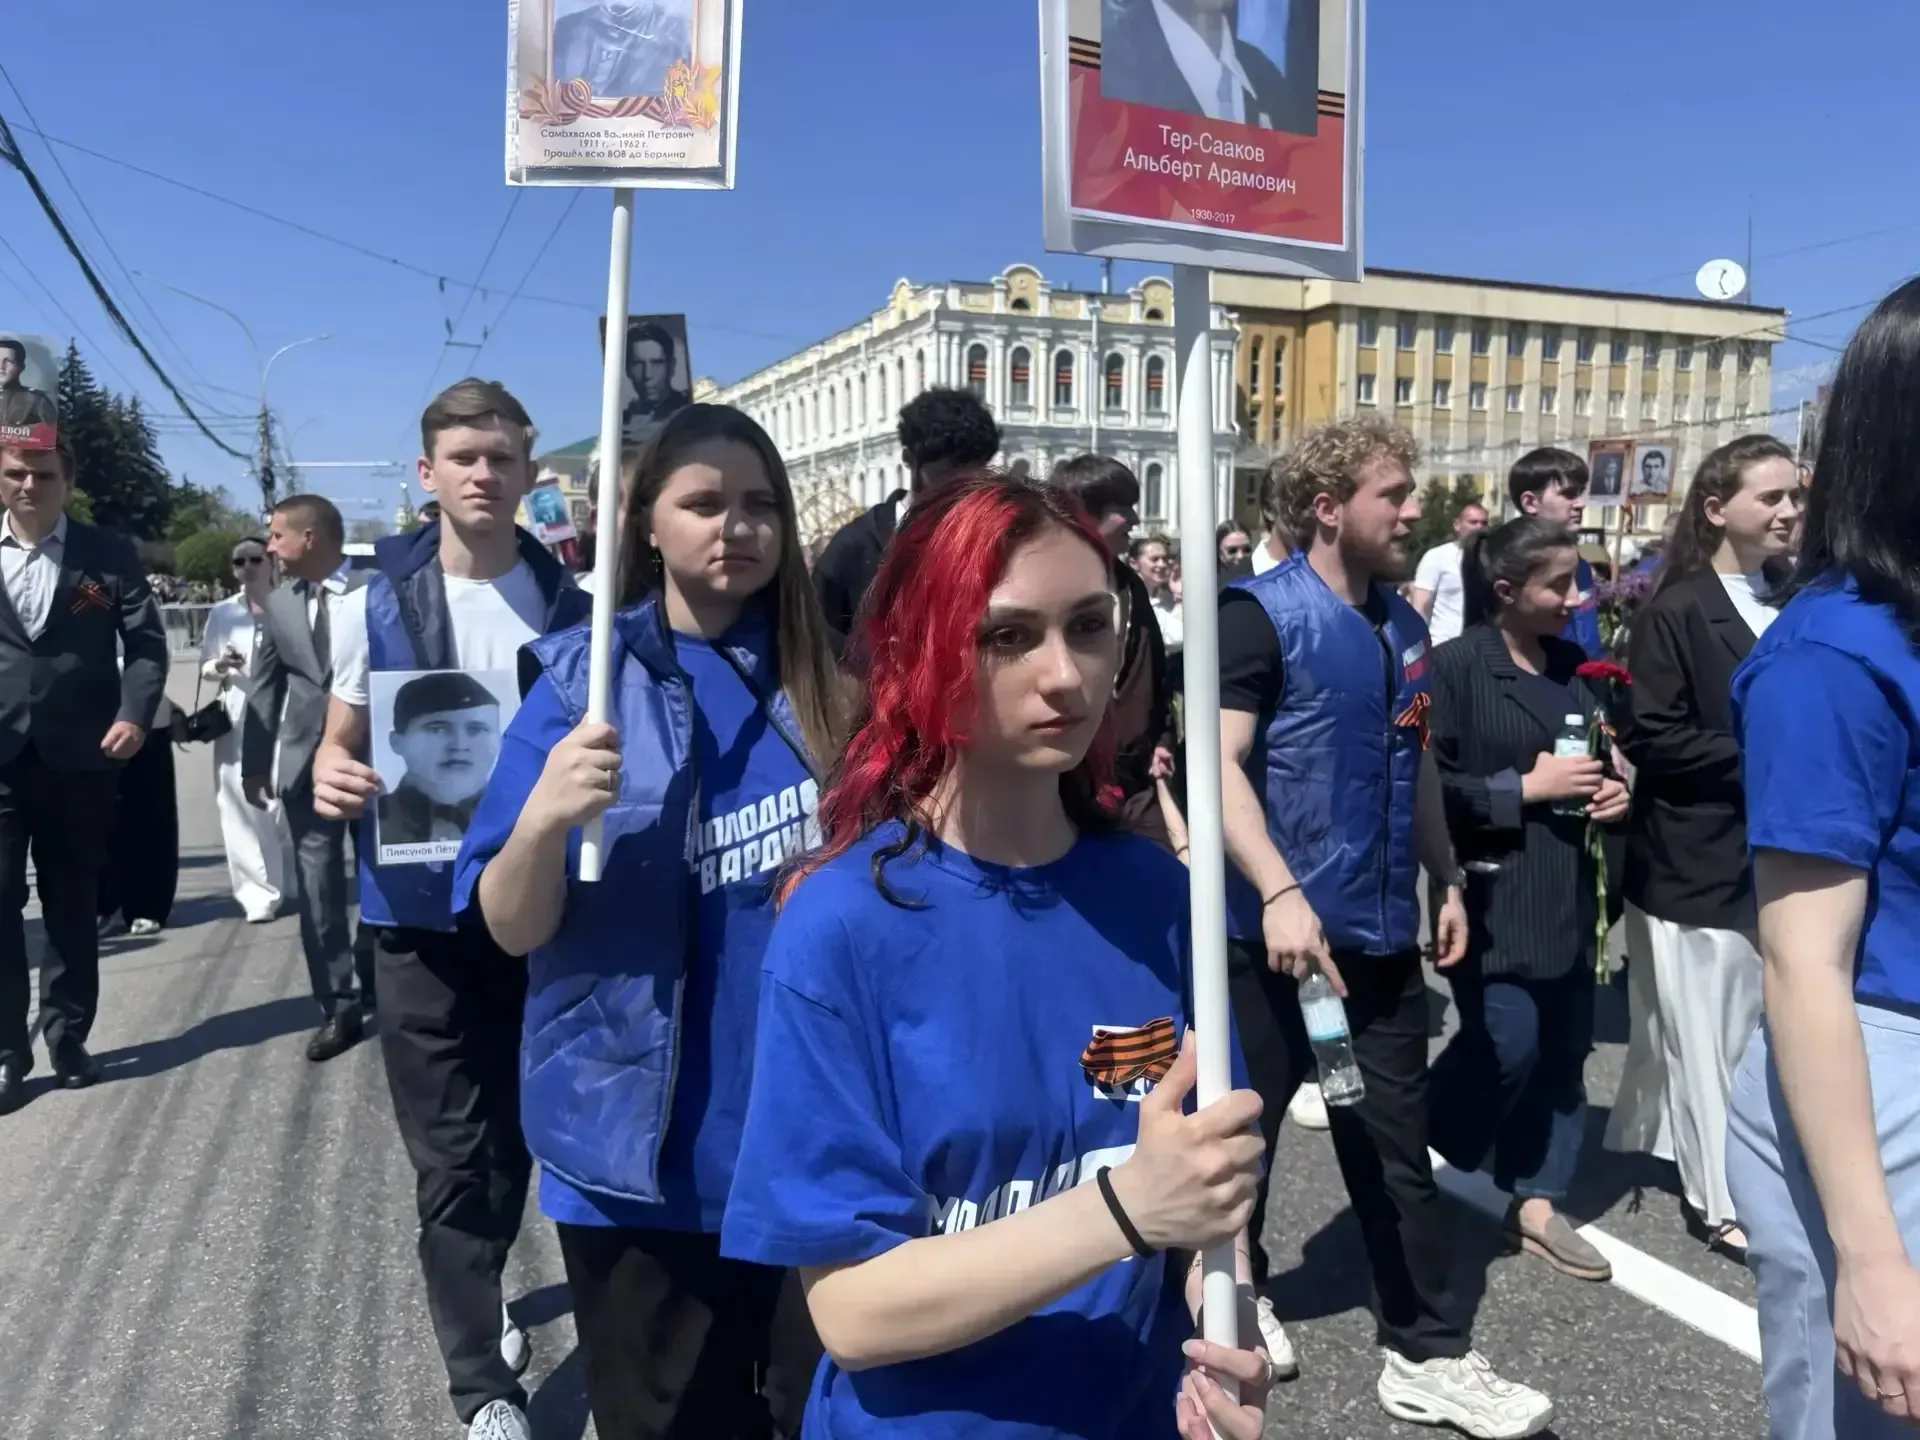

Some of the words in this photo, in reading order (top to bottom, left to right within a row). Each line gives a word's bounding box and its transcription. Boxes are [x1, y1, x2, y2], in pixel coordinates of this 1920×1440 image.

[648, 130, 694, 141] Петрович
[579, 139, 599, 149] 1911
[619, 139, 639, 149] 1962
[1158, 124, 1265, 162] Тер-Сааков
[585, 151, 605, 159] всю
[608, 150, 626, 158] ВОВ
[629, 151, 641, 159] до
[644, 150, 685, 160] Берлина
[1123, 147, 1202, 182] Альберт
[1208, 161, 1296, 195] Арамович
[1190, 208, 1235, 224] 1930-2017
[386, 847, 433, 857] Плясунов
